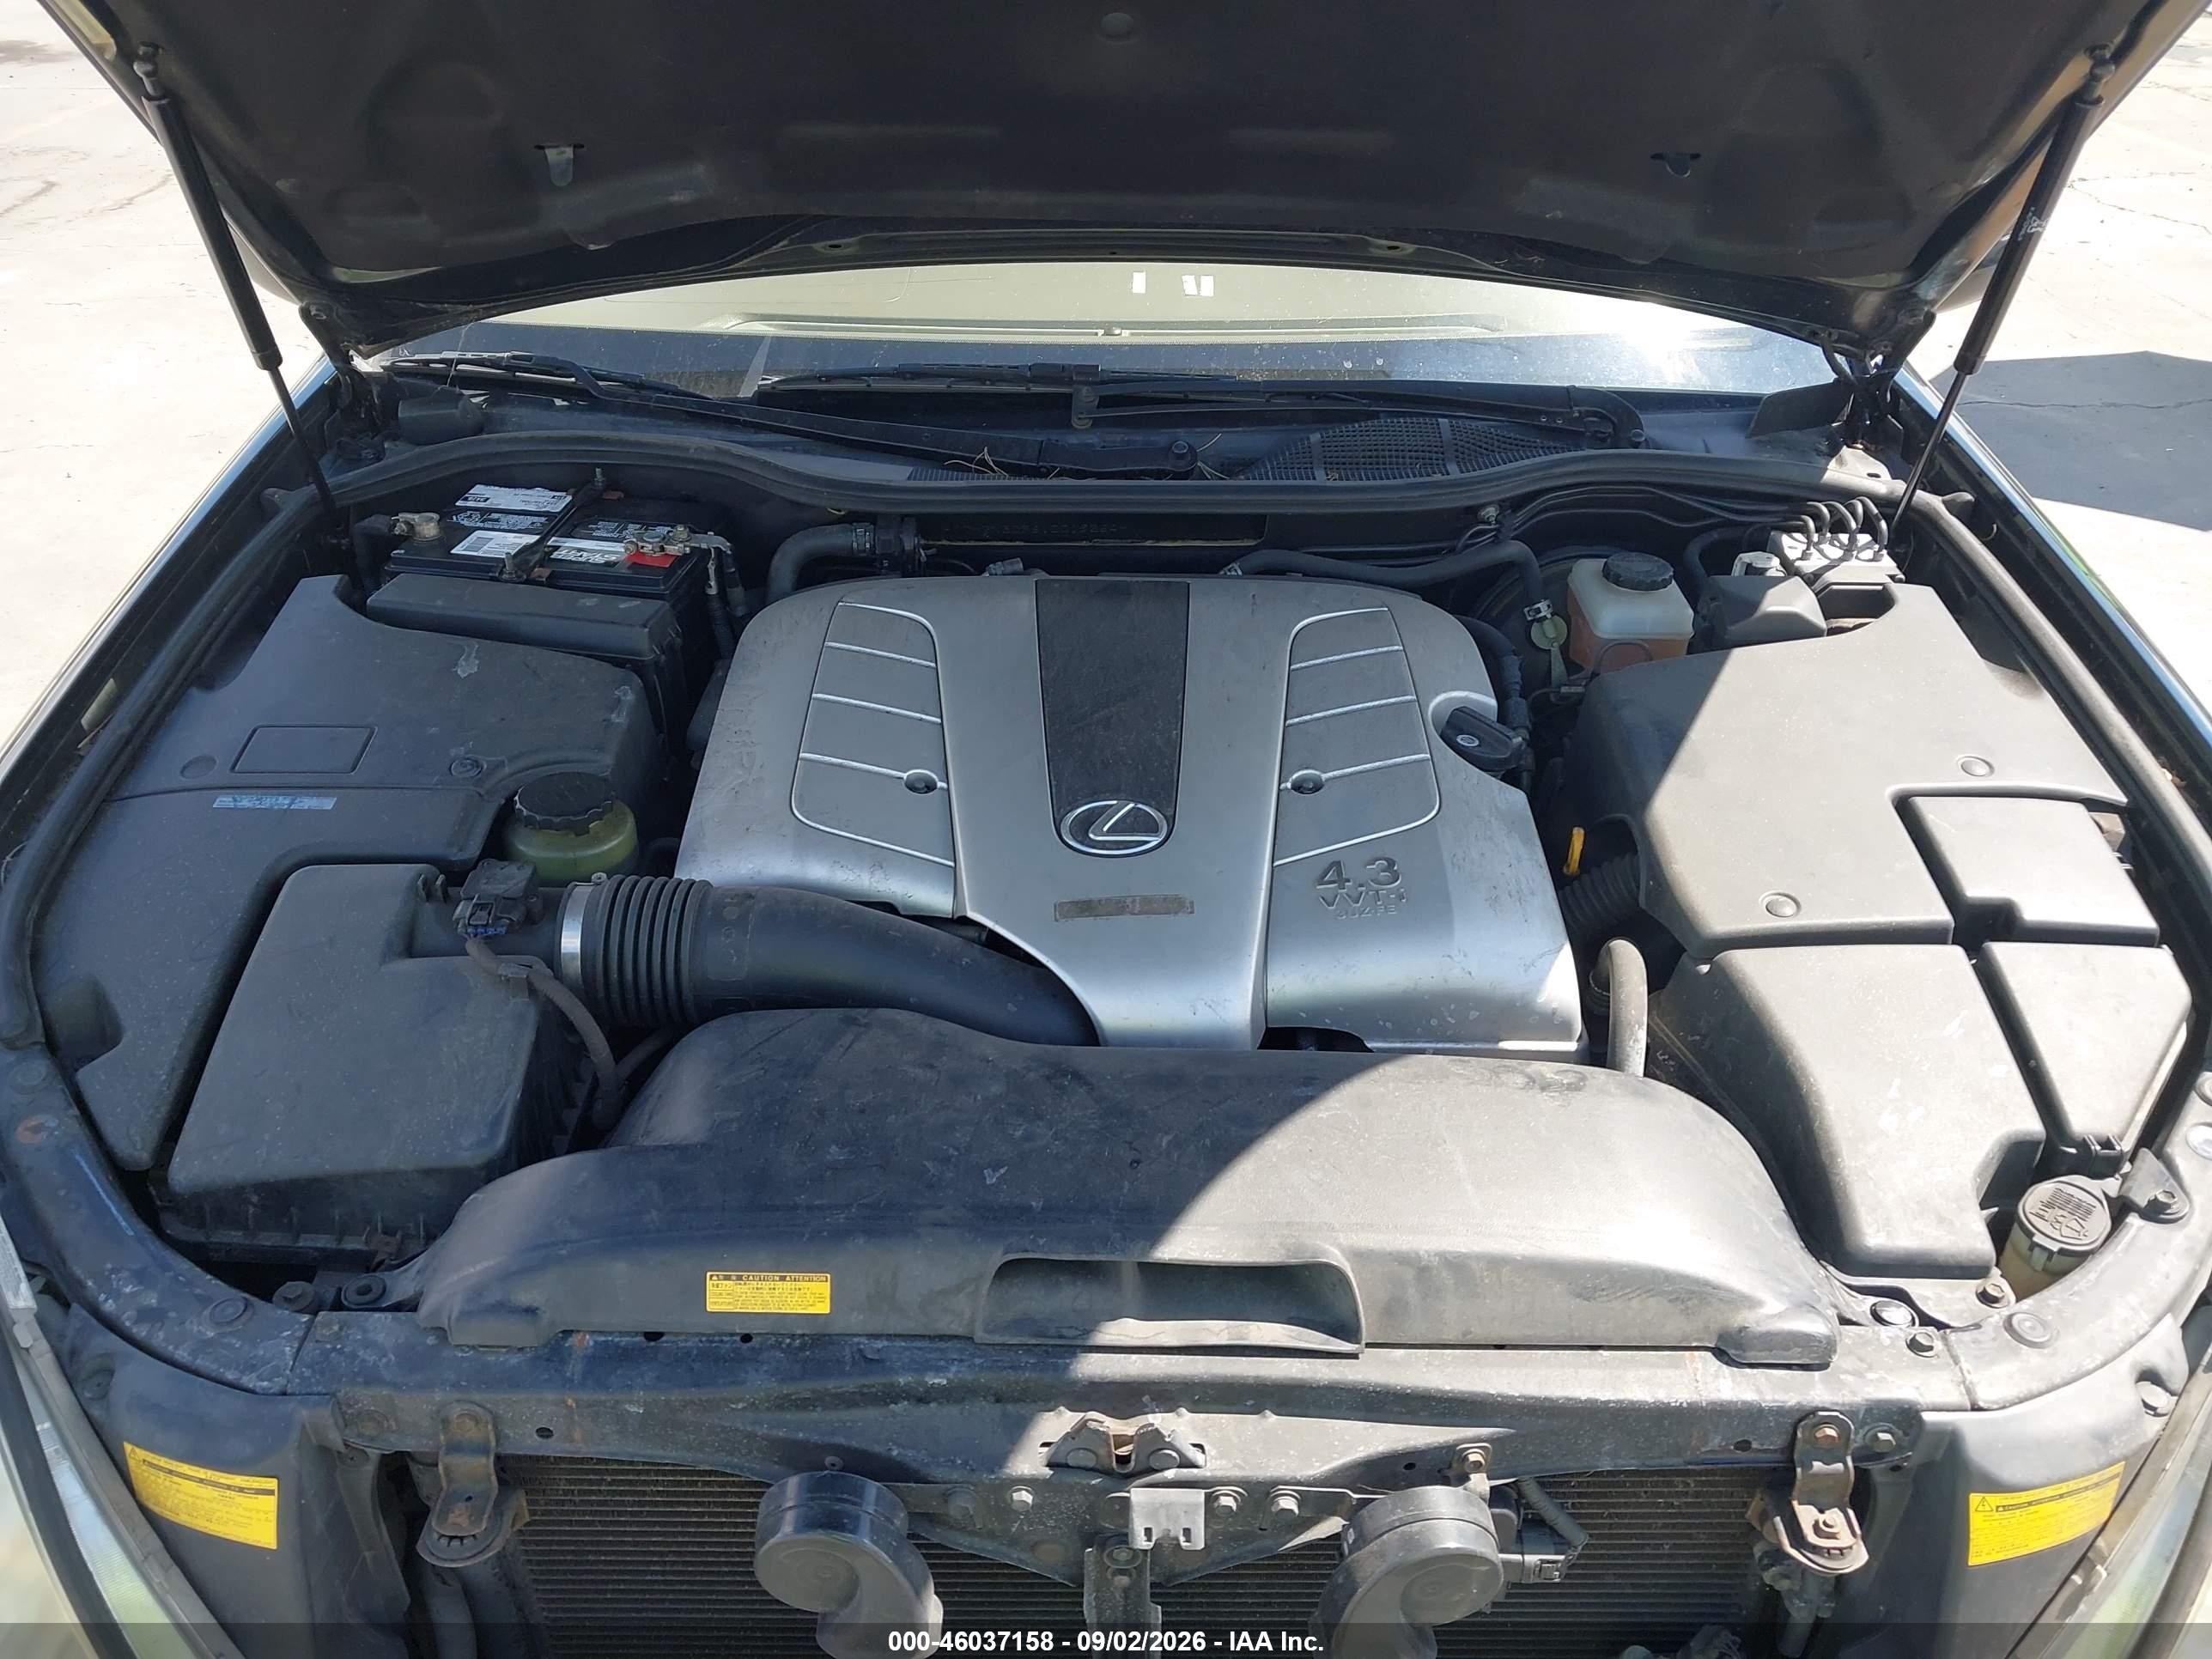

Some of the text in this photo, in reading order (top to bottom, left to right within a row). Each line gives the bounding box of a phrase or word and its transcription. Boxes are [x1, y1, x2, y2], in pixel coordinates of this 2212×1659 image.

[550, 554, 605, 564] SUPER
[1316, 857, 1402, 892] 4.3
[1318, 888, 1407, 909] VVT-i
